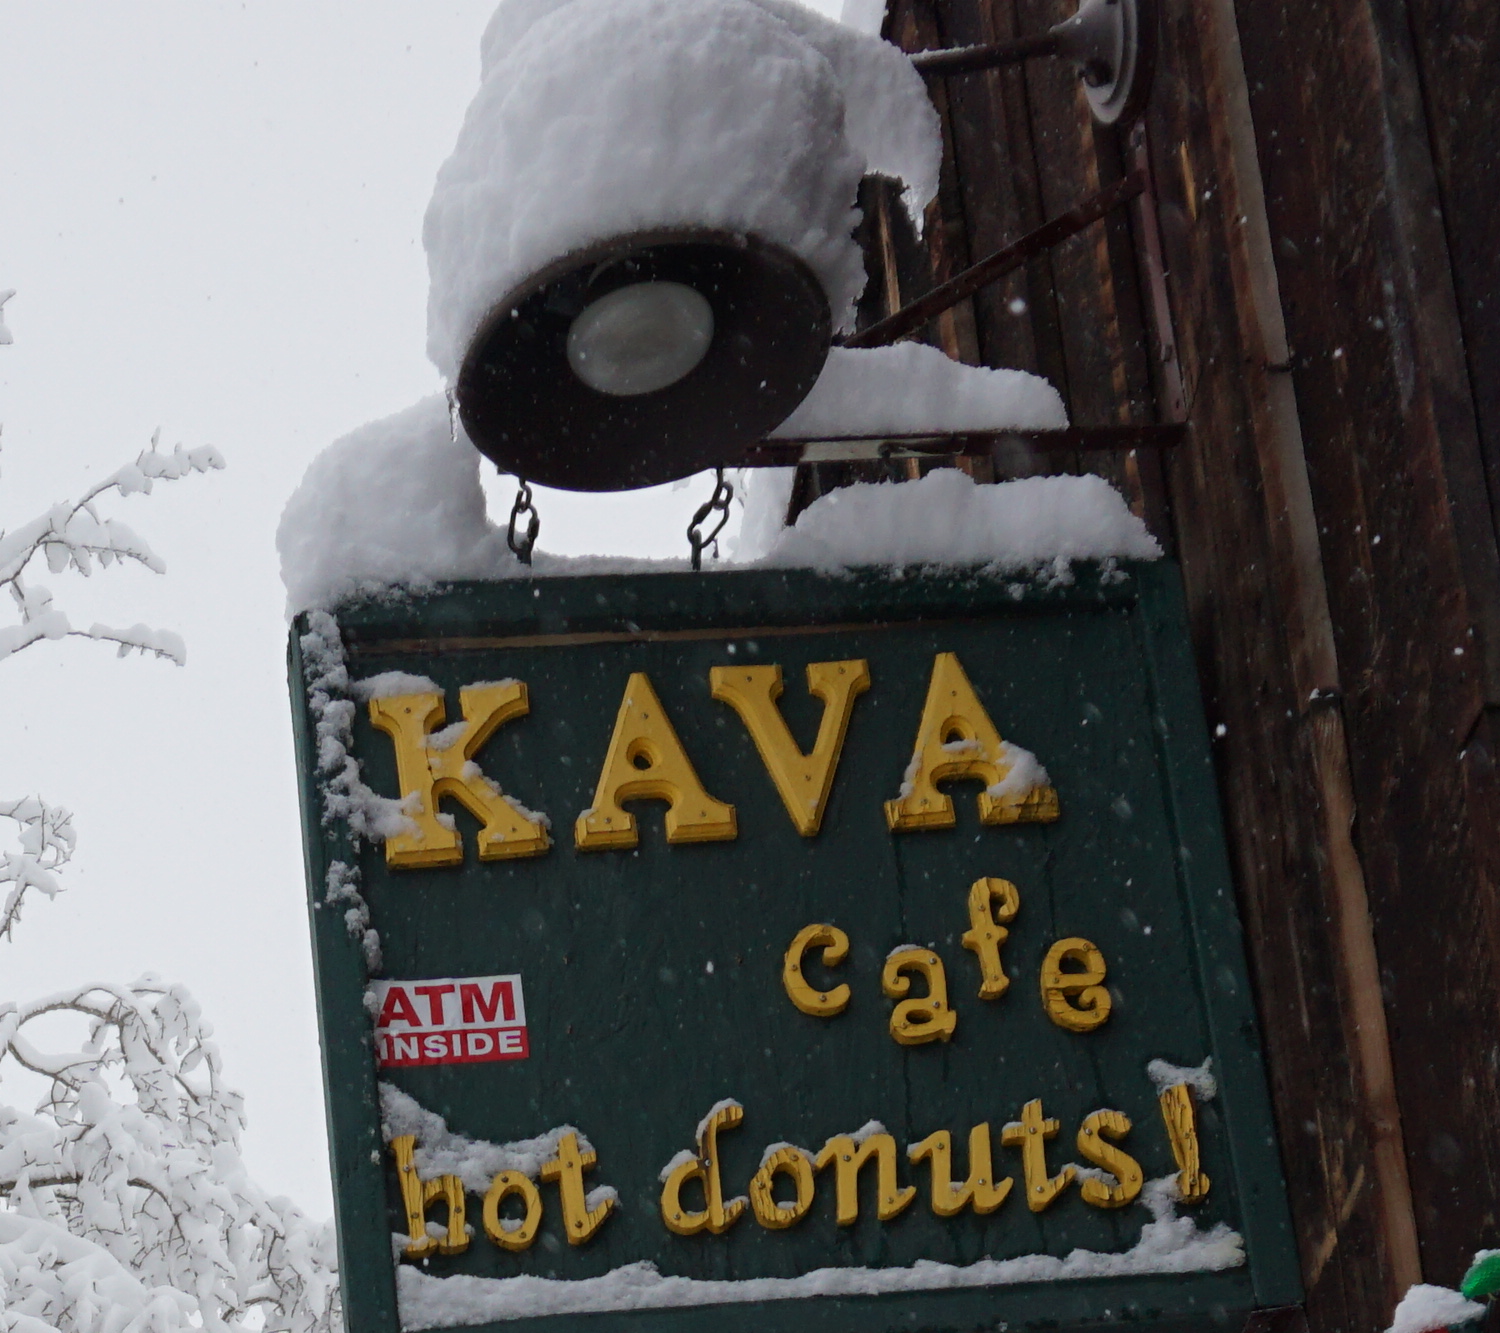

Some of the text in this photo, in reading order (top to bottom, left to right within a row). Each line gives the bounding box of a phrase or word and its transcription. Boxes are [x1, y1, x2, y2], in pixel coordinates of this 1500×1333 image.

[368, 652, 1062, 869] KAVA
[377, 981, 517, 1028] ATM
[783, 876, 1112, 1045] cafe
[379, 1030, 524, 1061] INSIDE
[390, 1084, 1211, 1260] hot donuts!
